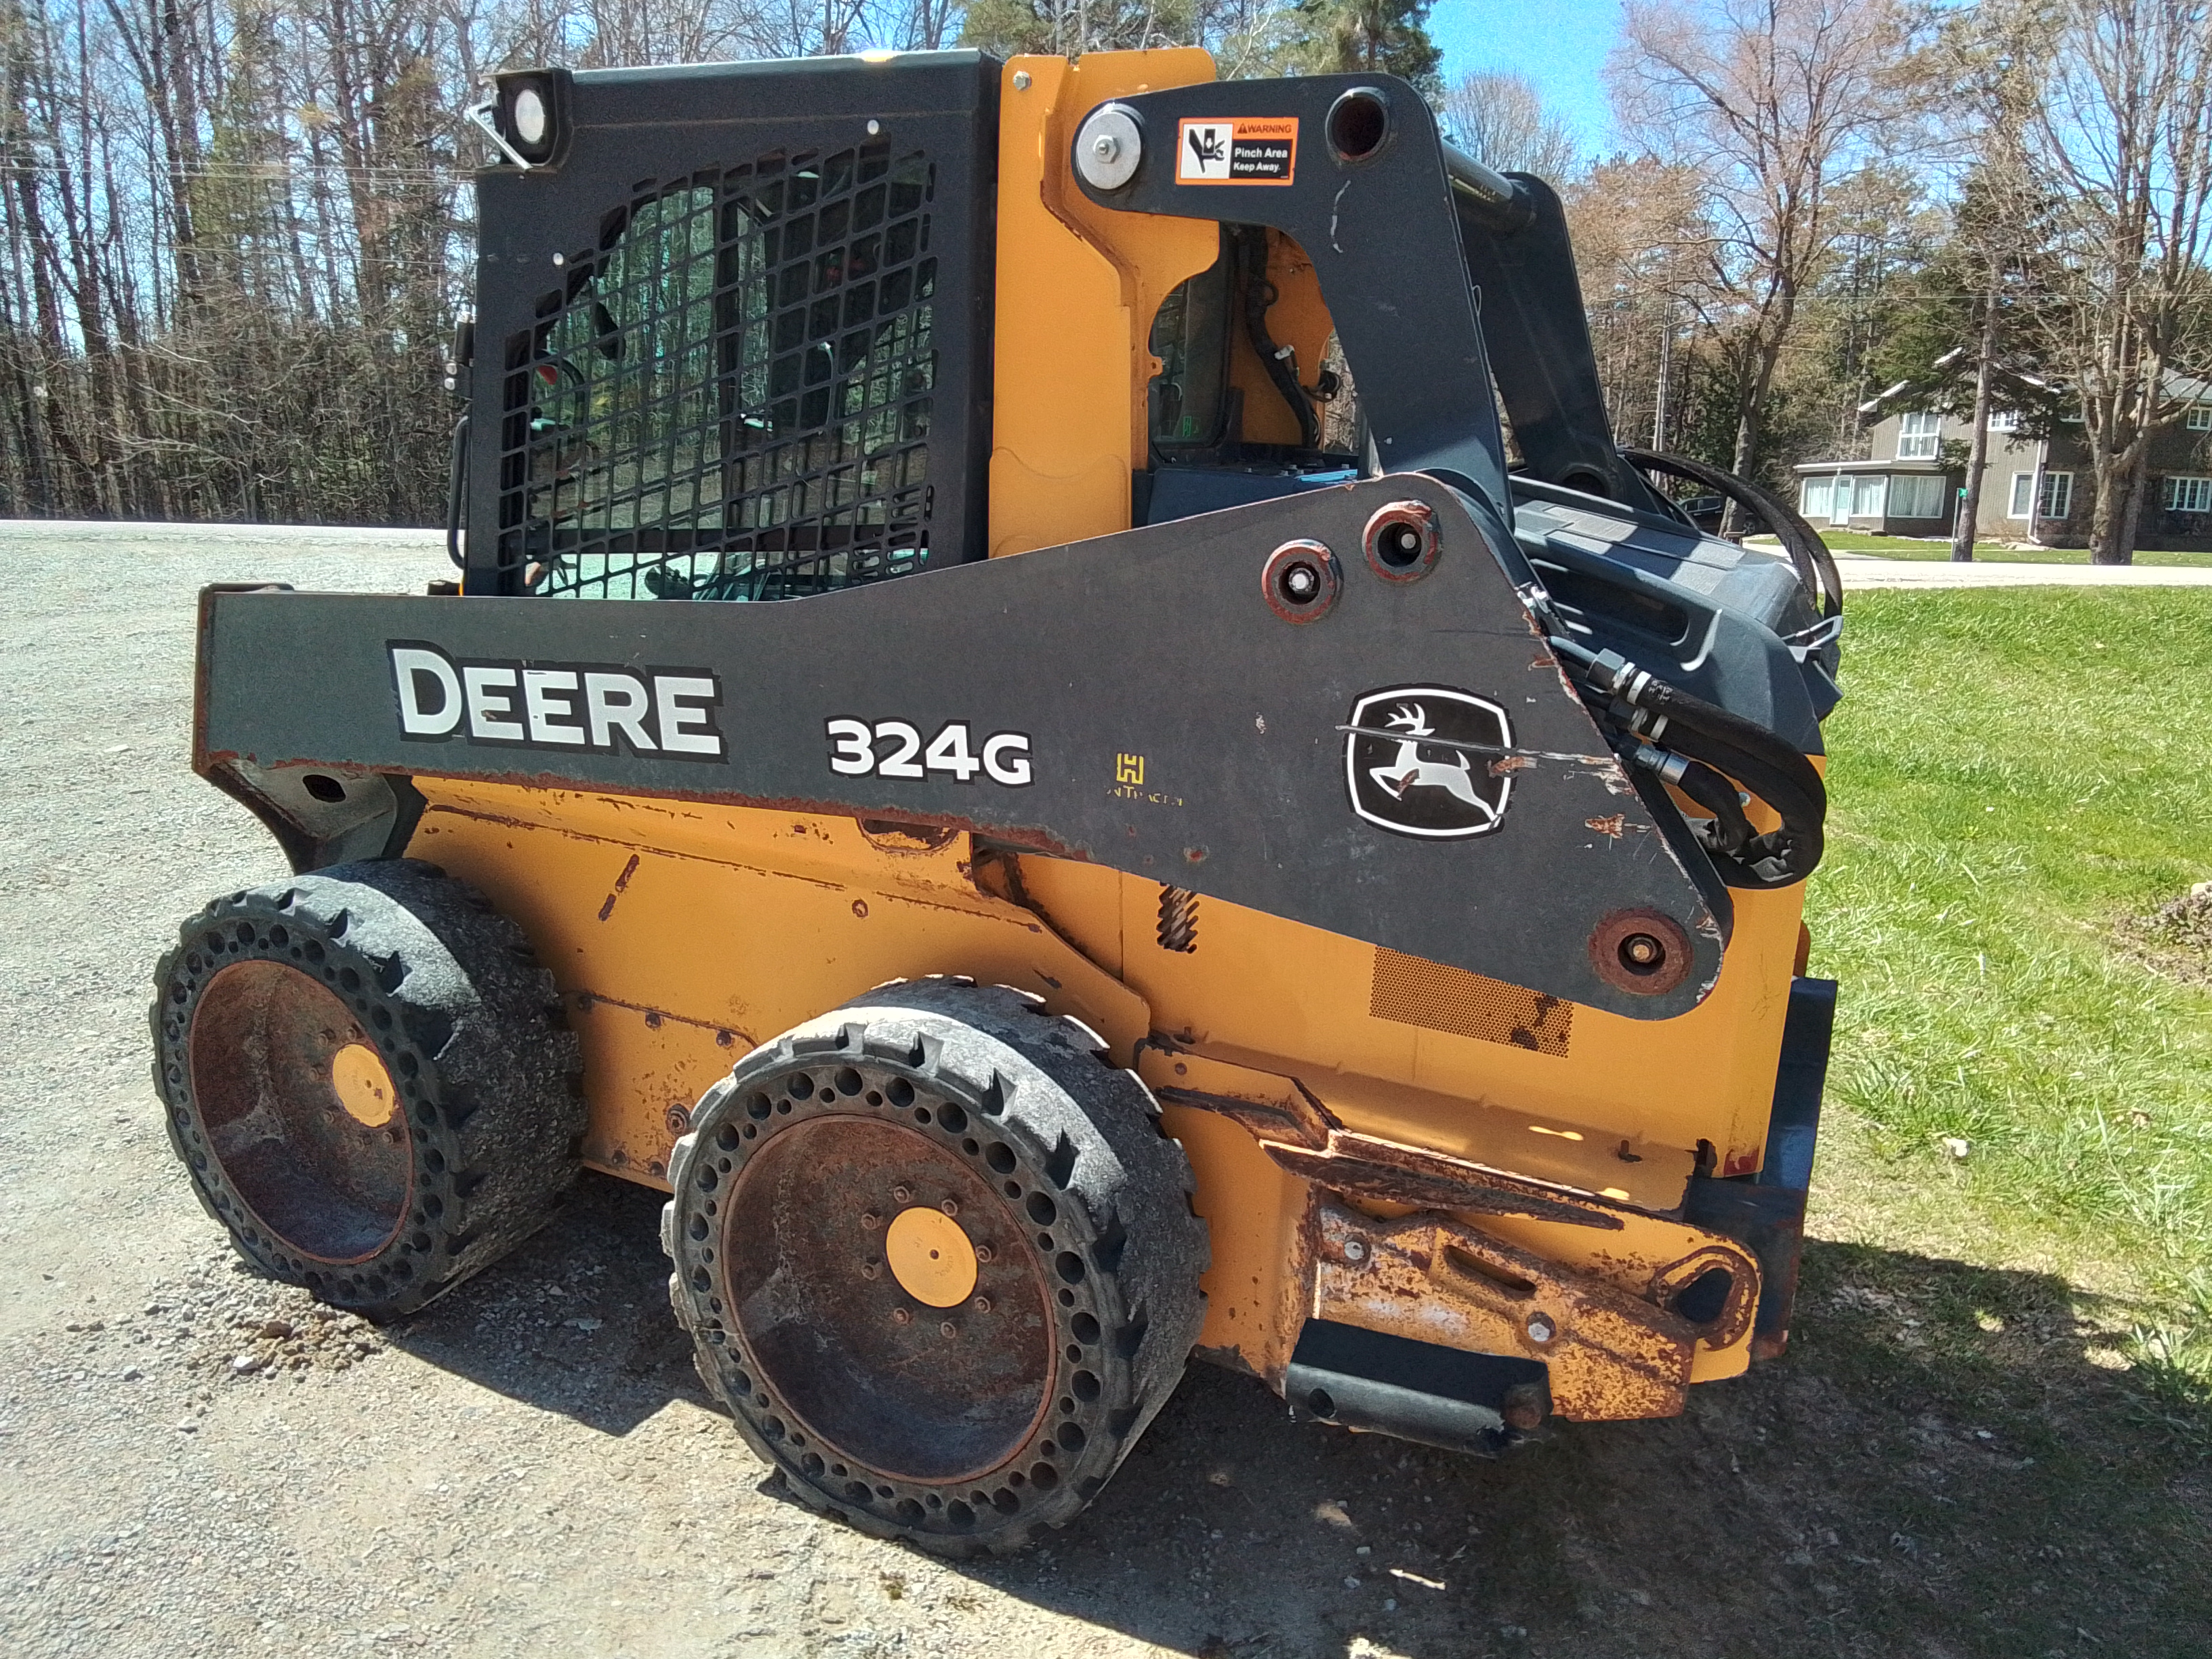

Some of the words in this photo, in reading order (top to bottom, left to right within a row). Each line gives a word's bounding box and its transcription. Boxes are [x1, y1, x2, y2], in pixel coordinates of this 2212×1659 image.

[1248, 124, 1292, 134] WARNING
[1234, 147, 1261, 158] Pinch
[1265, 147, 1288, 158] Area
[1233, 162, 1255, 172] Keep
[392, 648, 721, 755] DEERE
[827, 720, 1031, 785] 324G
